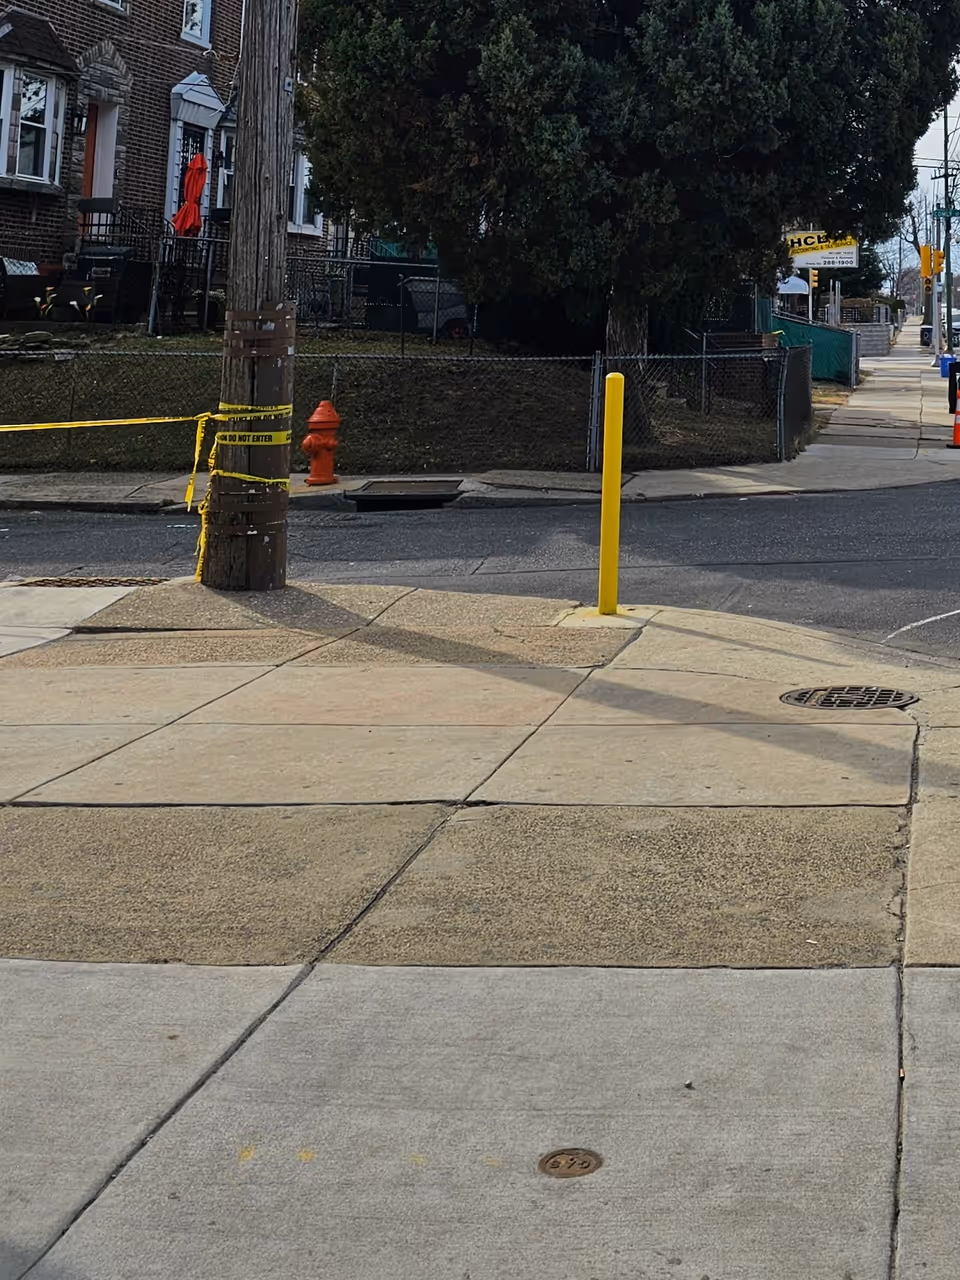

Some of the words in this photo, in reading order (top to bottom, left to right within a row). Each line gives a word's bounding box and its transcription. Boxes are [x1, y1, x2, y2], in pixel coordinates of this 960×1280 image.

[228, 434, 237, 442] DO
[238, 434, 251, 442] NOT
[252, 434, 273, 442] ENTER
